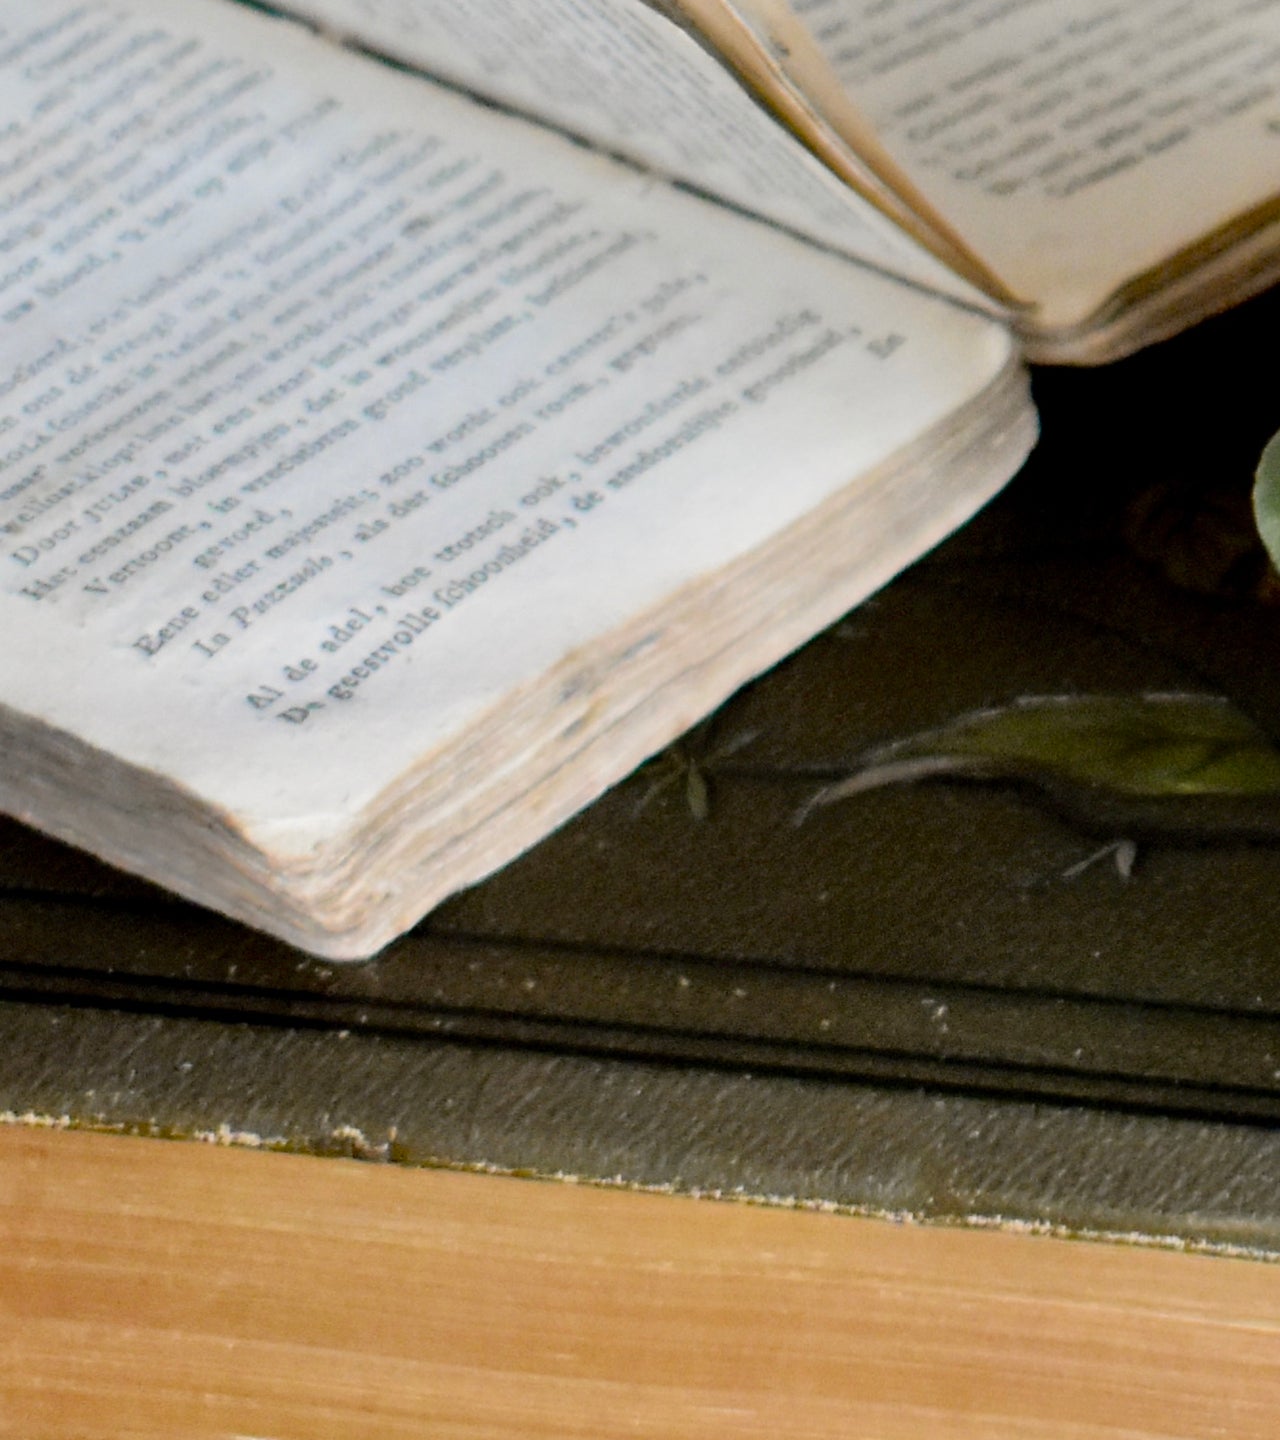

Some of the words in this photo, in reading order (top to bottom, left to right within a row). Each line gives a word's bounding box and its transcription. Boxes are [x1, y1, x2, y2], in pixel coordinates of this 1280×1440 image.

[10, 520, 81, 568] Door
[246, 686, 284, 711] Al
[283, 659, 318, 683] de
[320, 605, 387, 653] adel,
[380, 567, 432, 597] hoe
[519, 472, 582, 507] ook,
[326, 607, 441, 705] geestvolle
[571, 491, 603, 512] de
[131, 607, 199, 659] Eene
